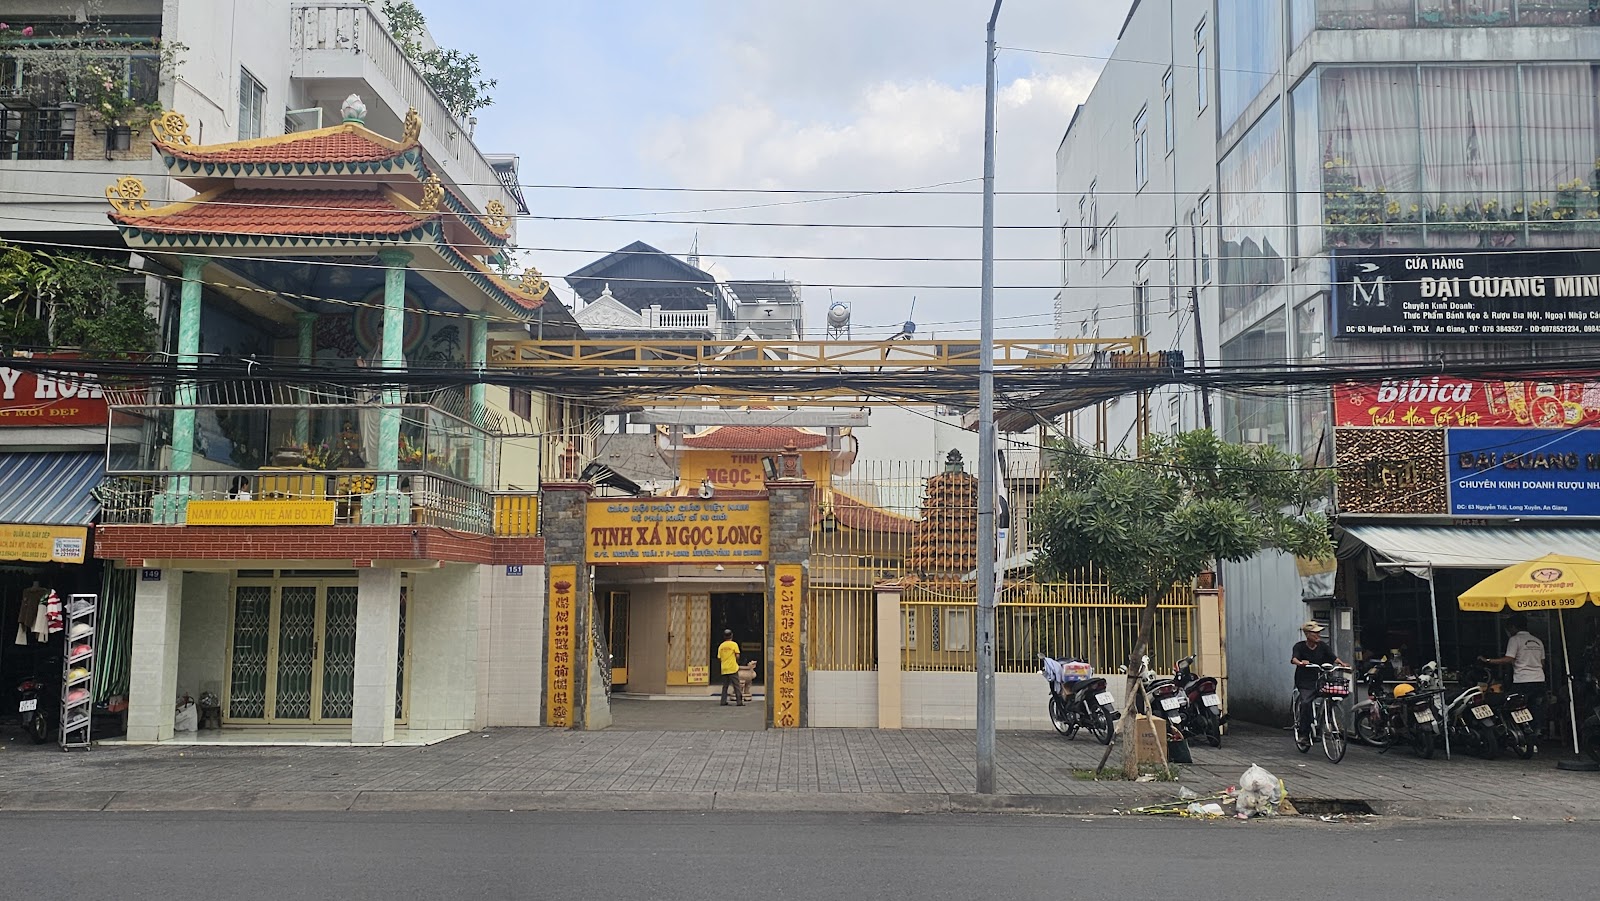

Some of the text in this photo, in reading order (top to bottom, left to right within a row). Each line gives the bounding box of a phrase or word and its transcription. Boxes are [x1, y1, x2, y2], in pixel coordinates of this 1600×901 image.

[1405, 253, 1464, 270] CỬA HÀNG
[1420, 275, 1600, 302] ĐẠI QUANG MIN
[1403, 302, 1475, 311] Chuyên Kinh Doanh:
[1403, 311, 1421, 320] Thực
[1423, 309, 1443, 320] Phẩm
[1446, 311, 1464, 320] Bánh
[1467, 311, 1480, 321] Kẹo
[1492, 311, 1510, 321] Rượu
[1545, 311, 1566, 321] Ngoại
[1568, 311, 1588, 321] Nhập
[1368, 325, 1391, 334] Nguyễn
[1413, 325, 1429, 333] TPLX
[1436, 325, 1445, 333] An
[1446, 325, 1467, 334] Giang,
[1482, 325, 1494, 333] 076
[1496, 325, 1523, 333] 3843527
[1377, 377, 1473, 403] Bibica
[49, 408, 79, 419] ĐẸP
[731, 454, 758, 467] TỊNH
[1500, 451, 1580, 470] QUANG
[705, 468, 751, 487] NGỌC
[1459, 479, 1497, 489] CHUYÊN
[1523, 481, 1555, 490] DOANH
[1557, 481, 1585, 491] RƯỢU
[607, 502, 749, 514] GIÁO HỘI PHẬT GIÁO VIỆT NAM
[1475, 503, 1496, 511] Nguyễn
[191, 508, 212, 520] NAM
[214, 507, 229, 520] MÔ
[230, 508, 256, 520] QUAN
[279, 507, 293, 519] ÂM
[310, 507, 328, 519] TÁT
[591, 521, 762, 550] TỊNH XÁ NGỌC LONG
[144, 570, 159, 578] 149
[1559, 598, 1575, 606] 999
